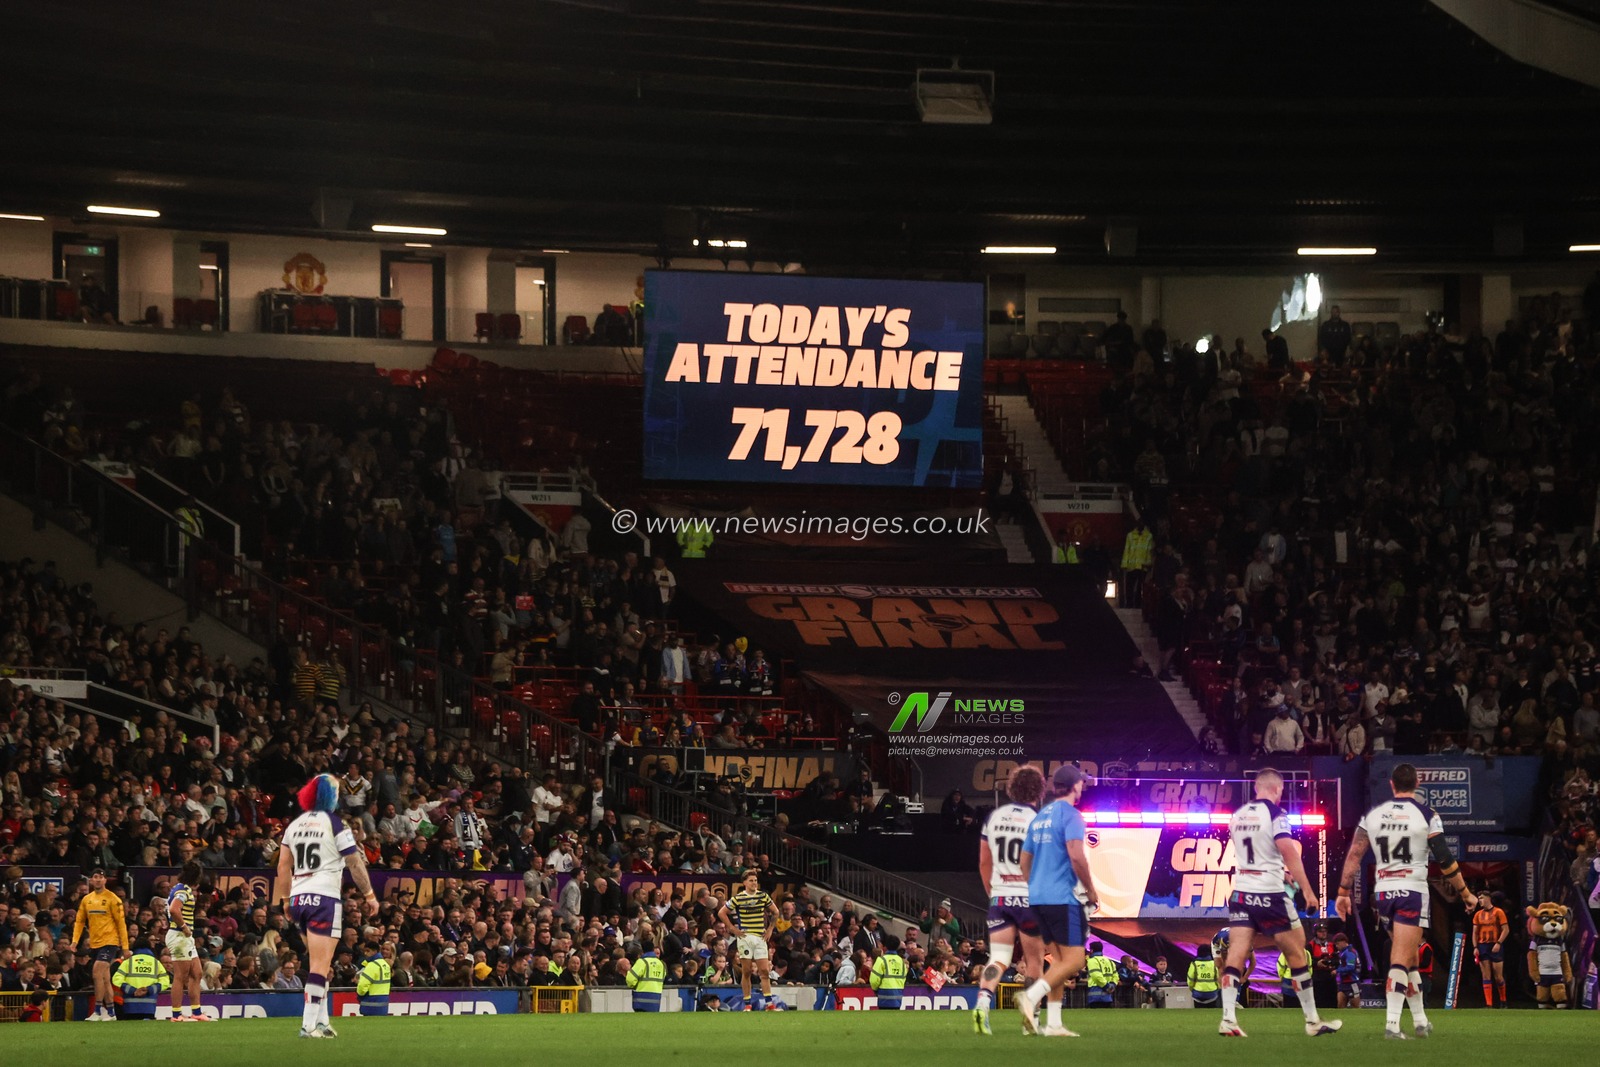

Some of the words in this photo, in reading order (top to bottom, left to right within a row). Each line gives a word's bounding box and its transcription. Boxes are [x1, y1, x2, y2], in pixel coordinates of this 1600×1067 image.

[723, 302, 911, 348] TODAY'S
[664, 342, 964, 391] ATTENDANCE
[728, 407, 902, 470] 71,728
[728, 583, 836, 595] BETFRED
[877, 586, 948, 597] SUPER
[950, 587, 1040, 598] LEAGUE
[746, 594, 1060, 625] GRAND
[794, 620, 1066, 650] FINAL
[1416, 770, 1467, 781] ETFRED
[1150, 783, 1233, 803] GRAND
[1430, 789, 1467, 799] SUPER
[1430, 799, 1467, 808] LEAGUE
[1380, 823, 1408, 831] PITTS
[295, 843, 320, 870] 16
[995, 836, 1025, 865] 10
[1242, 837, 1255, 865] 1
[1375, 836, 1412, 864] 14
[1467, 844, 1508, 853] BETFRED
[298, 895, 321, 907] SAS
[1004, 897, 1030, 908] SAS
[1245, 894, 1271, 907] SAS
[1385, 889, 1410, 900] SAS
